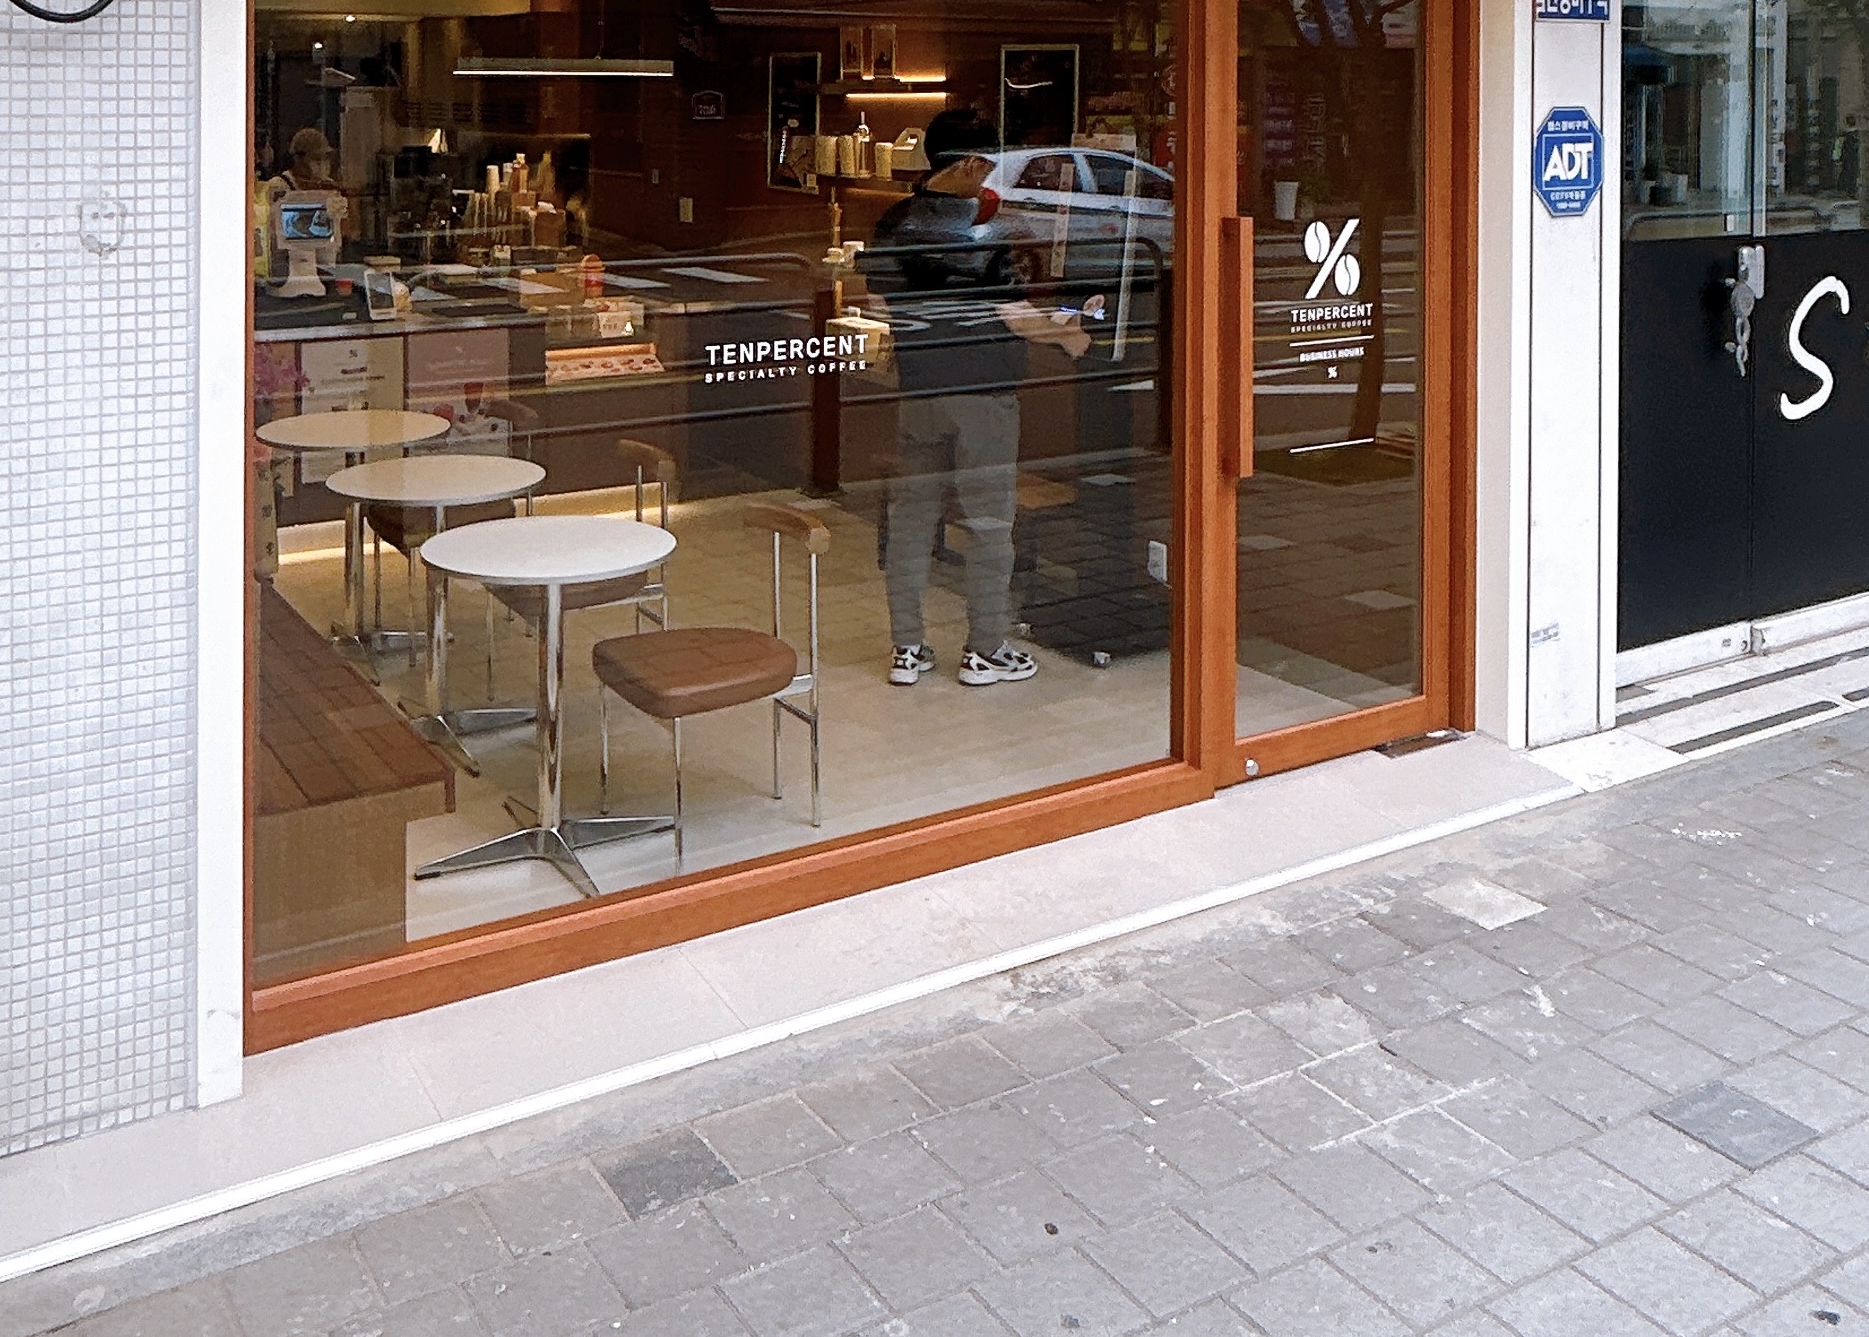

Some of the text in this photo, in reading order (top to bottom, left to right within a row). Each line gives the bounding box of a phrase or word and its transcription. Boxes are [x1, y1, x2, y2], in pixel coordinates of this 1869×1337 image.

[1543, 143, 1592, 182] ADT
[1291, 303, 1373, 323] TENPERCENT
[705, 334, 869, 366] TENPERCENT
[704, 360, 866, 384] SPECIALTY COFFEE
